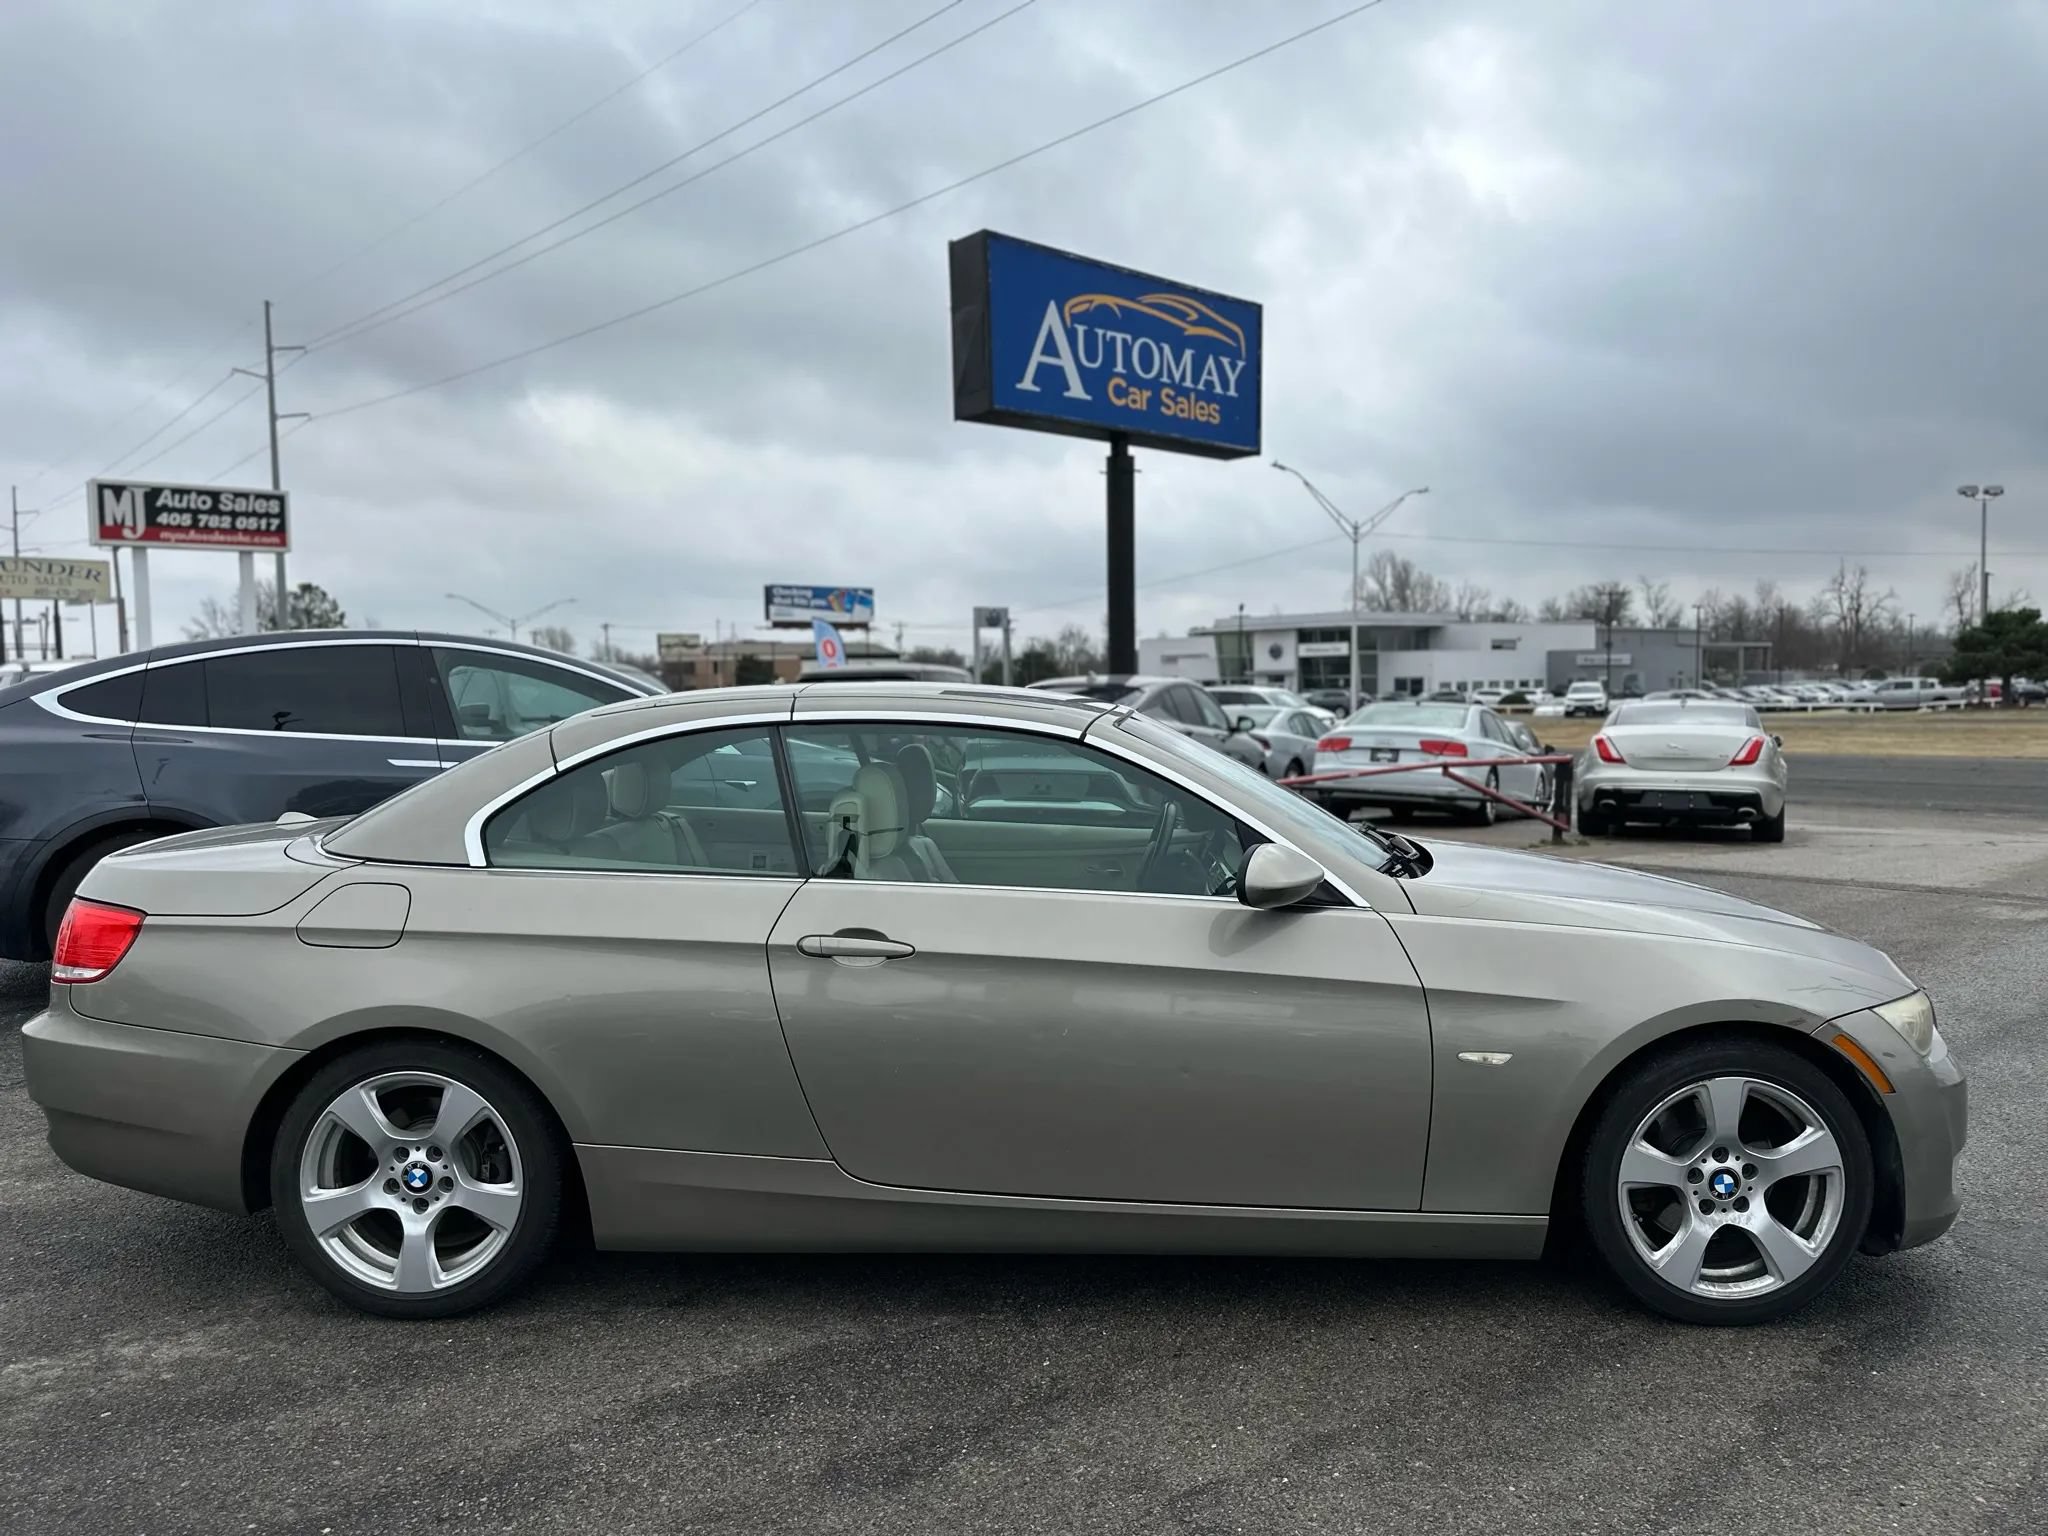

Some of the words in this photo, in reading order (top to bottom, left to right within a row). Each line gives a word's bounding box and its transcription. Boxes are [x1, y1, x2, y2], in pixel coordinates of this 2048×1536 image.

[1015, 299, 1246, 401] AUTOMAY
[1107, 376, 1152, 411] Car
[1159, 386, 1221, 425] Sales
[102, 486, 152, 539] MJ
[155, 488, 213, 511] Auto
[218, 492, 280, 515] Sales
[156, 511, 193, 527] 405
[197, 513, 233, 529] 782
